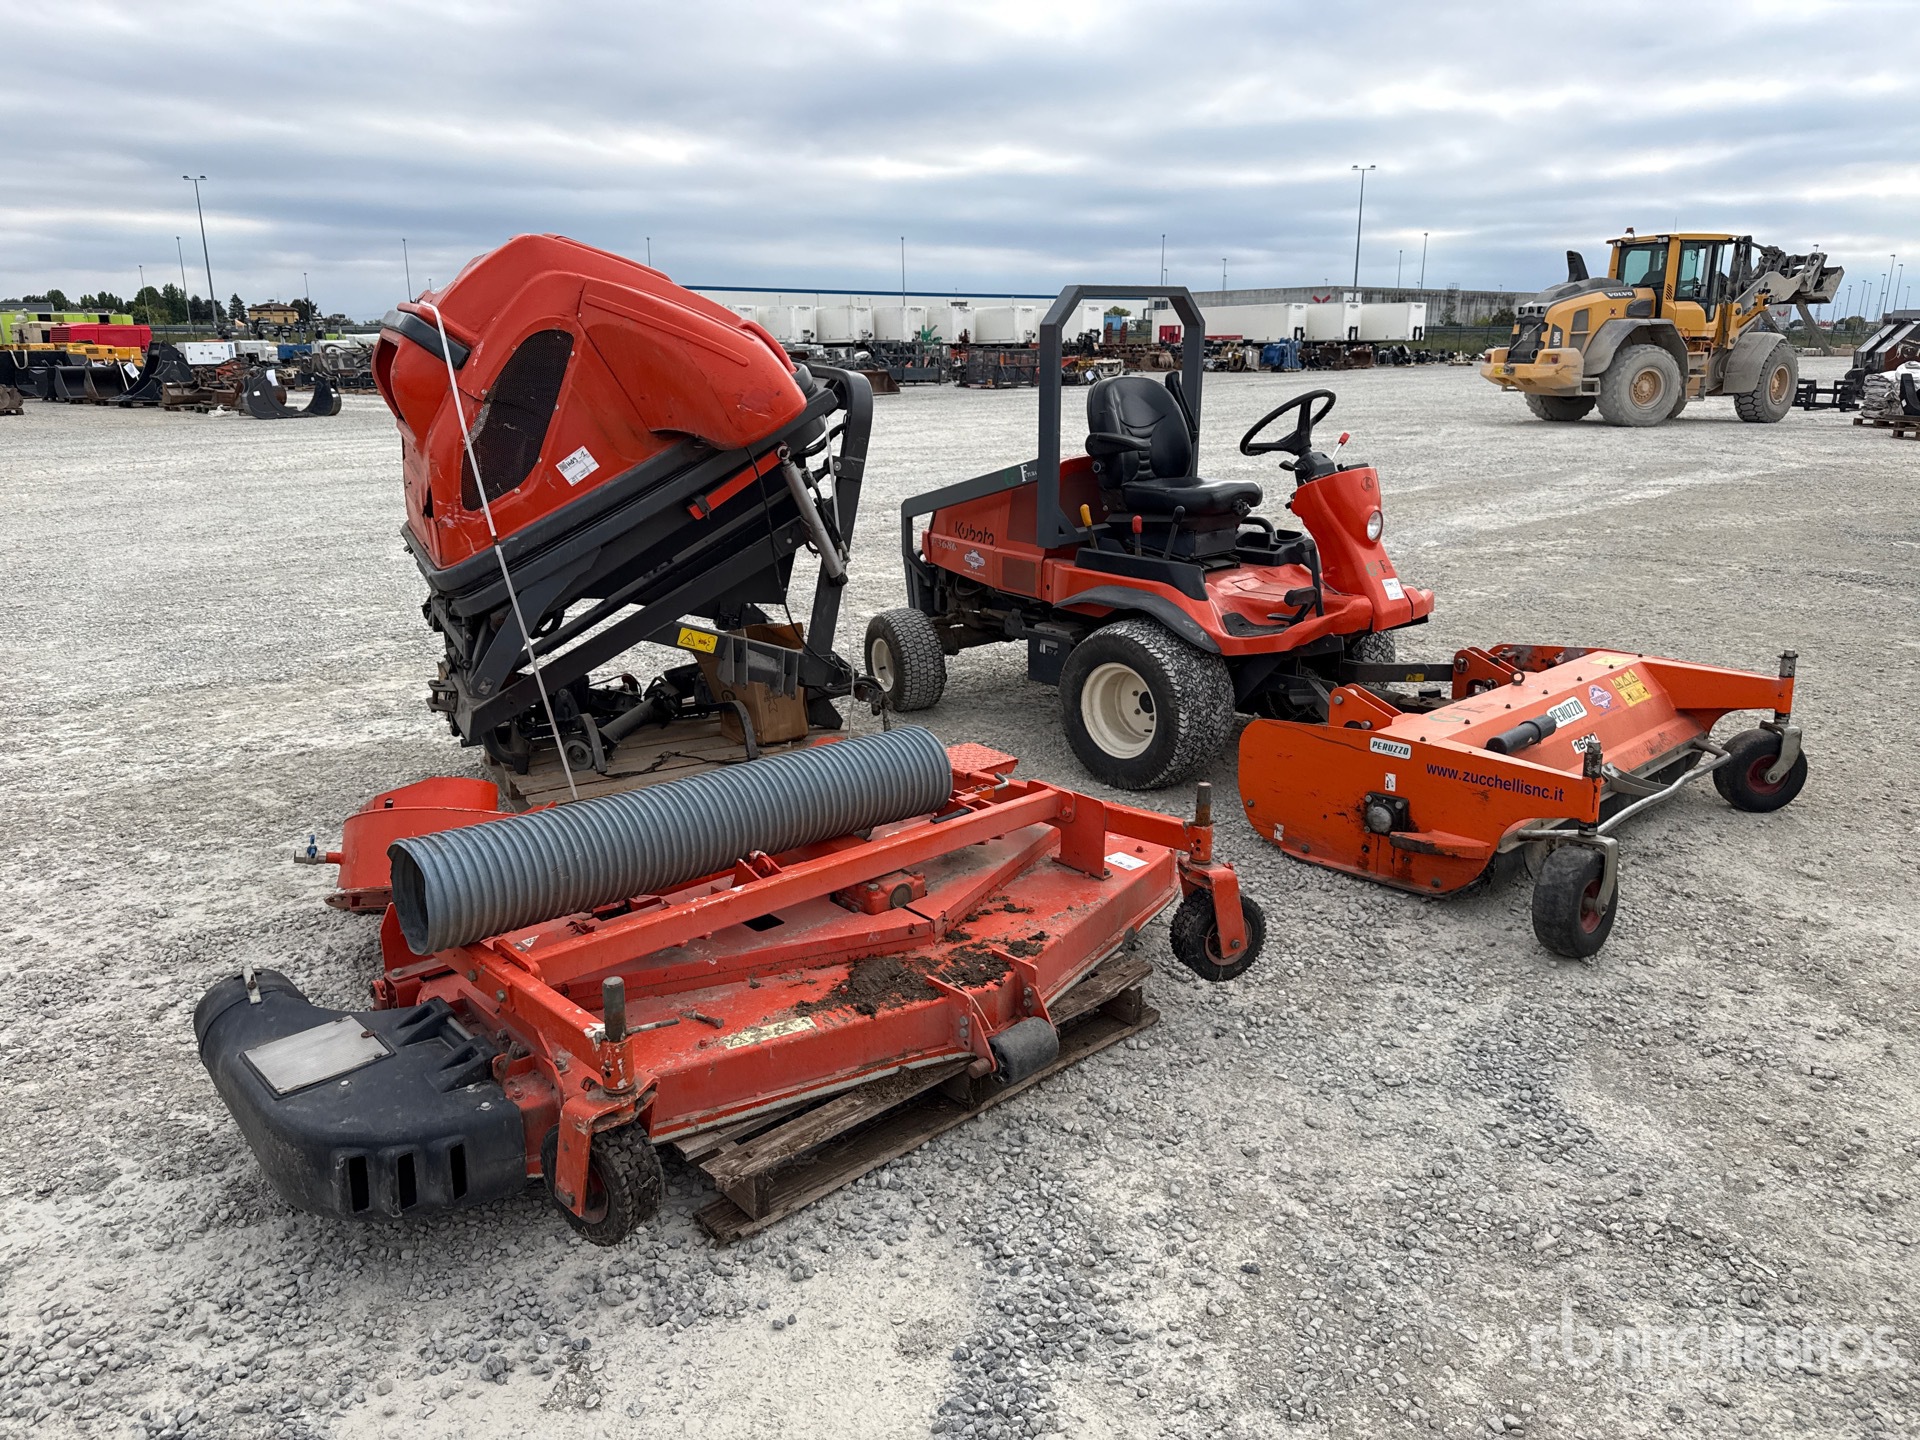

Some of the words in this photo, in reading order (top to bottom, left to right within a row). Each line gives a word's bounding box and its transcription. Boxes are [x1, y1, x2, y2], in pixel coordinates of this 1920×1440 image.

[1553, 331, 1561, 346] L90H
[955, 521, 994, 545] Kubota
[1549, 700, 1584, 722] PERUZZO
[1371, 740, 1410, 756] PERUZZO
[1426, 763, 1565, 802] www.zucchellisnc.it
